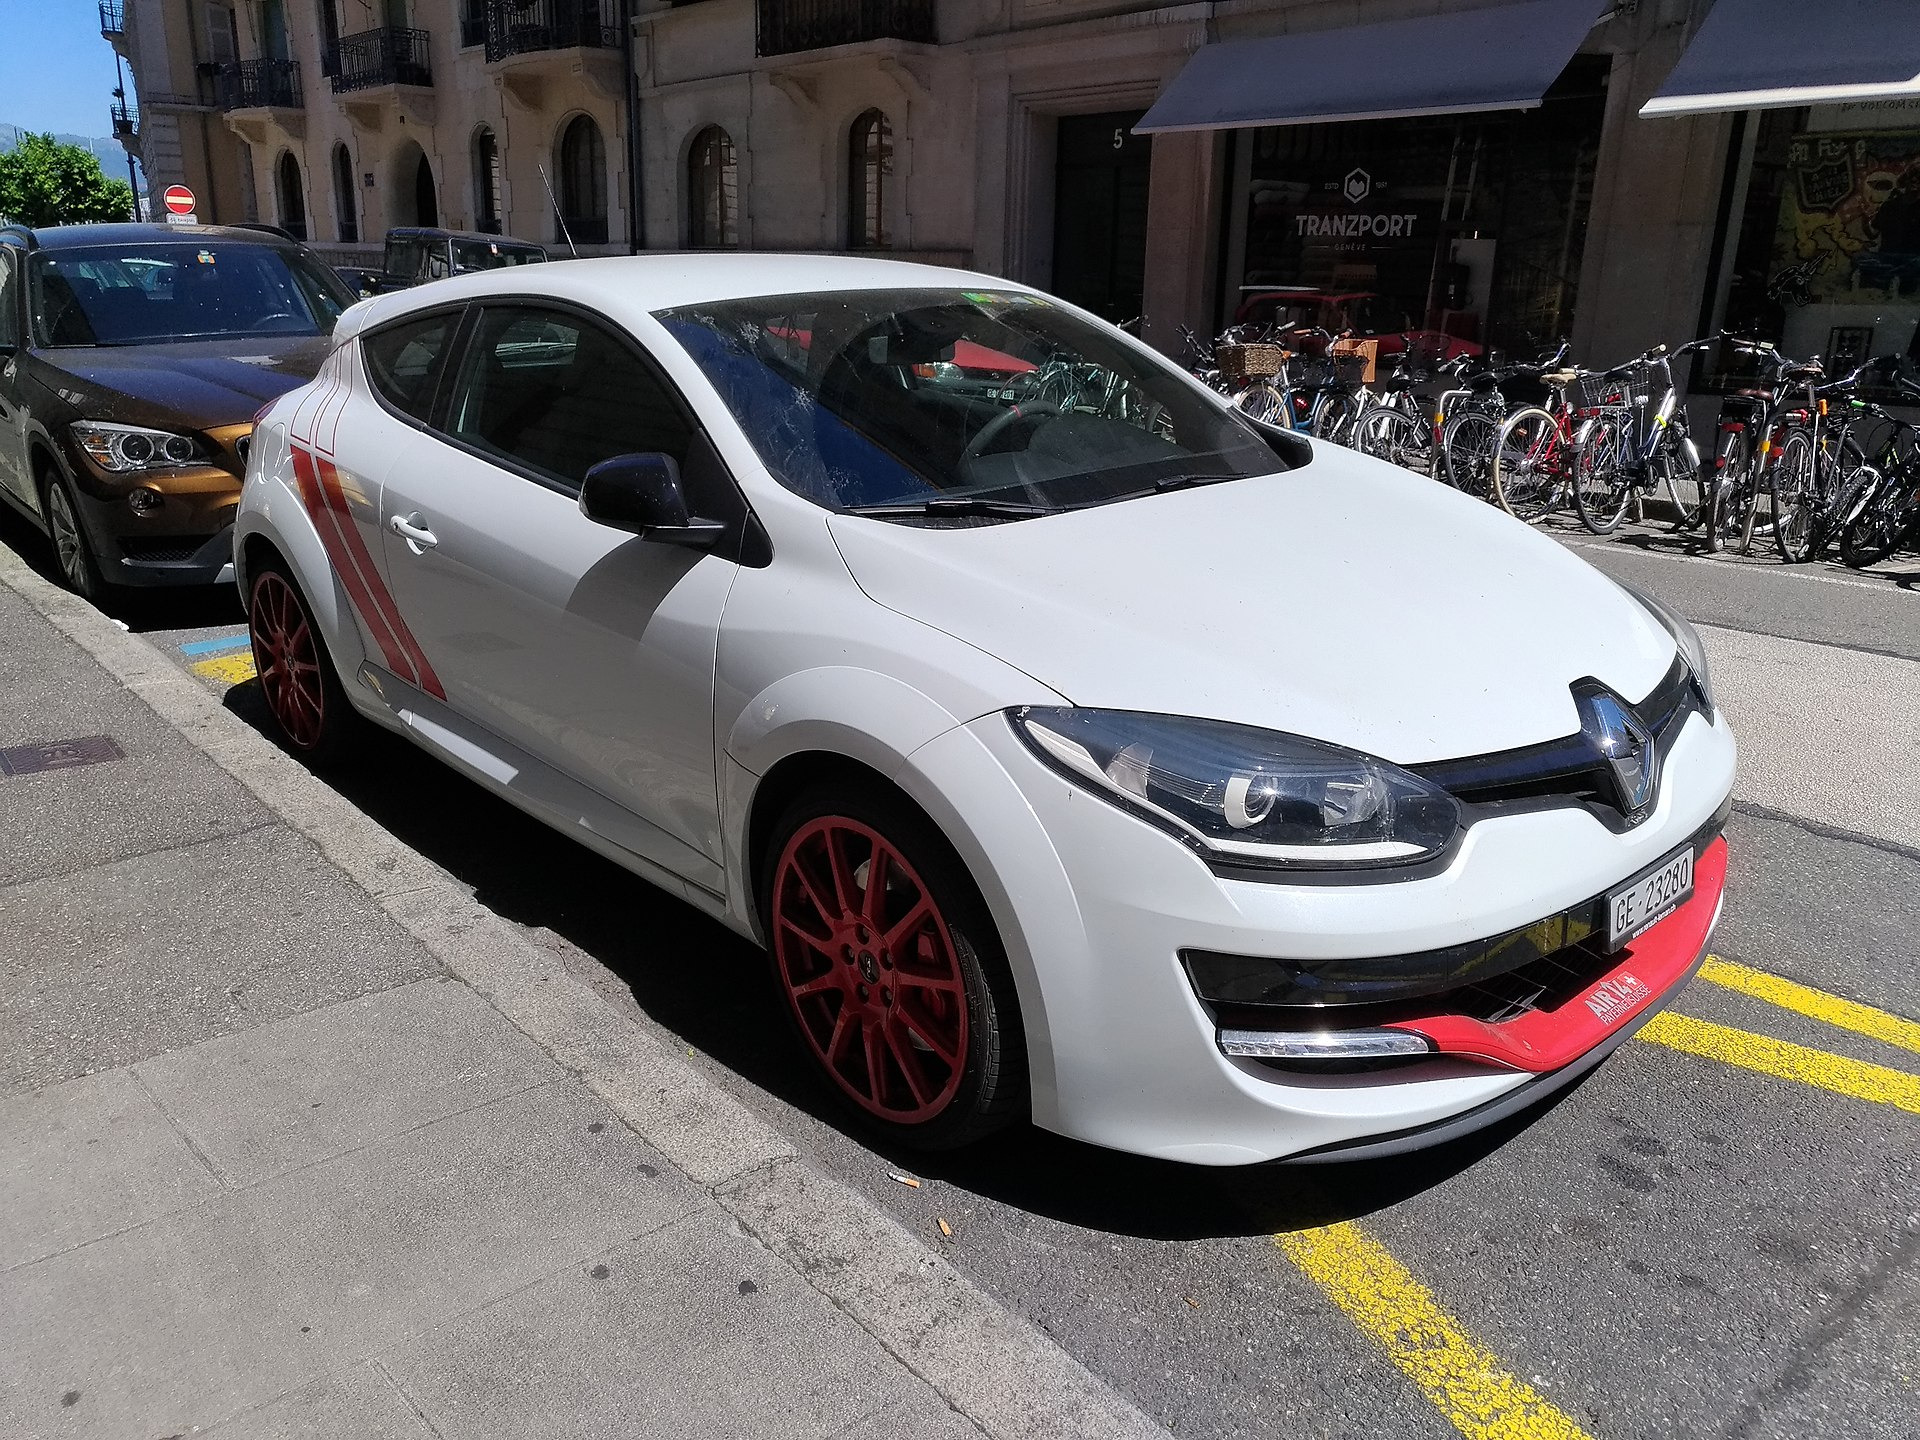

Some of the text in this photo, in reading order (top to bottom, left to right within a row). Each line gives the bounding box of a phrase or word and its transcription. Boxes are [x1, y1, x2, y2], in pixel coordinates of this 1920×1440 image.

[1113, 128, 1123, 149] 5
[1295, 214, 1417, 237] TRANZPORT
[1334, 242, 1366, 251] GENÈVE
[1645, 857, 1688, 915] 23280
